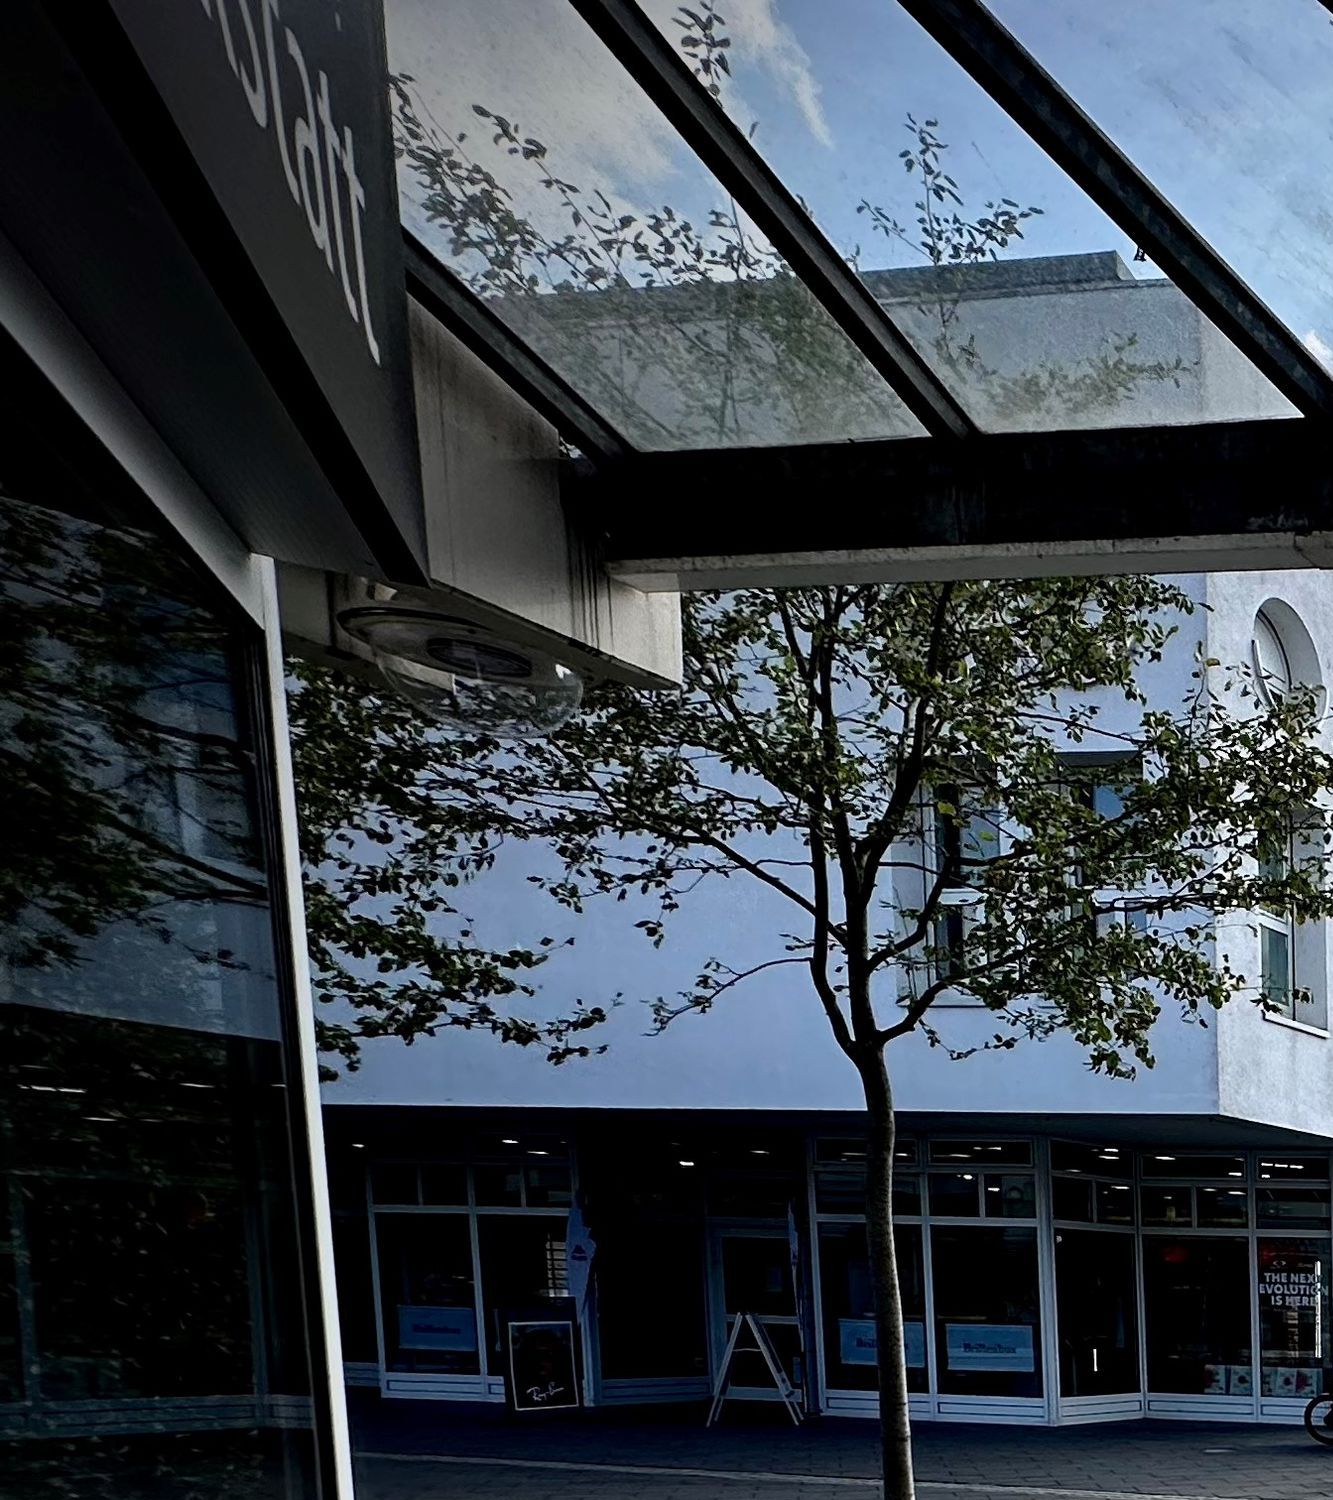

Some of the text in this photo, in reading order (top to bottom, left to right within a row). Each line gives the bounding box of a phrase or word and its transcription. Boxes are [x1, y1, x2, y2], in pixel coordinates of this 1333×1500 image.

[1264, 1272, 1288, 1283] THE
[1259, 1283, 1329, 1296] EVOLUTION
[1270, 1295, 1283, 1306] IS
